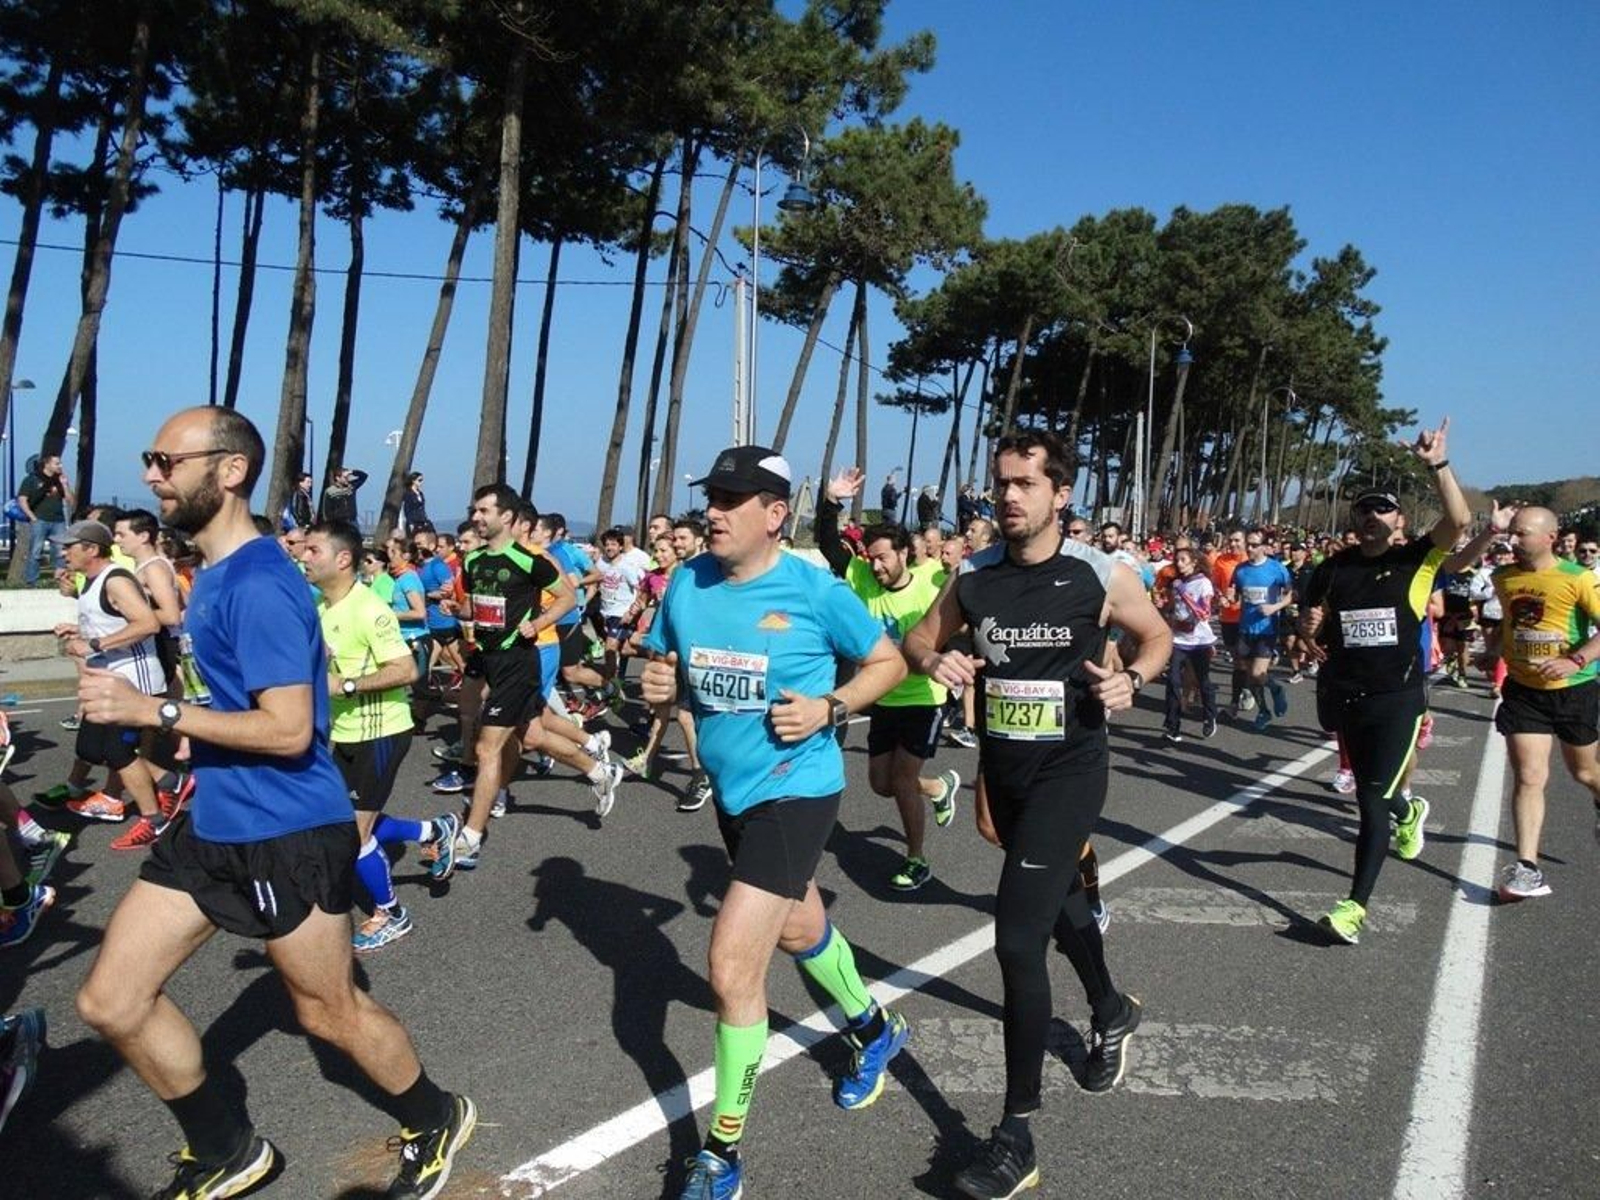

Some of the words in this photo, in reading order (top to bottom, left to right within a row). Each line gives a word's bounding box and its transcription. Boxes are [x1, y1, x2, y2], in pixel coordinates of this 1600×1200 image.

[991, 622, 1073, 648] aquática
[1350, 621, 1386, 638] 2639
[711, 655, 750, 668] VIG-BAY
[700, 671, 750, 701] 4620
[1003, 685, 1046, 695] VIG-BAY
[999, 701, 1044, 727] 1237
